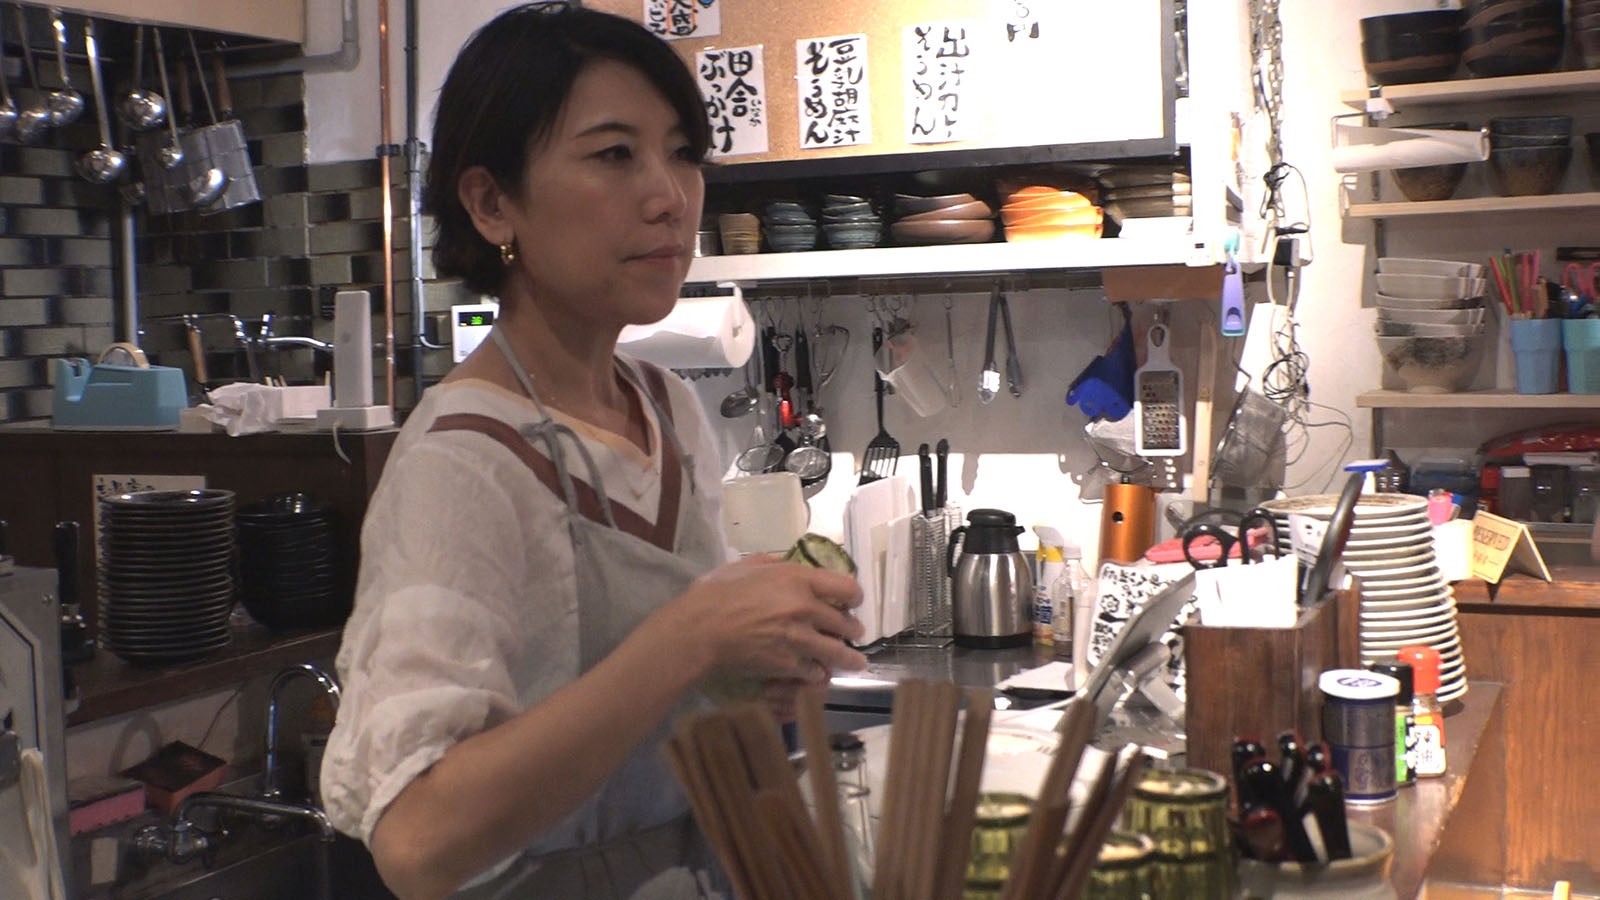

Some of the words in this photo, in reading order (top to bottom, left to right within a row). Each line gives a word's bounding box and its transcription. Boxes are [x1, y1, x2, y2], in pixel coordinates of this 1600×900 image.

[726, 50, 758, 117] 田舎
[804, 41, 829, 144] そうめん
[828, 38, 863, 144] 豆乳胡麻汁
[911, 26, 936, 136] そうめん
